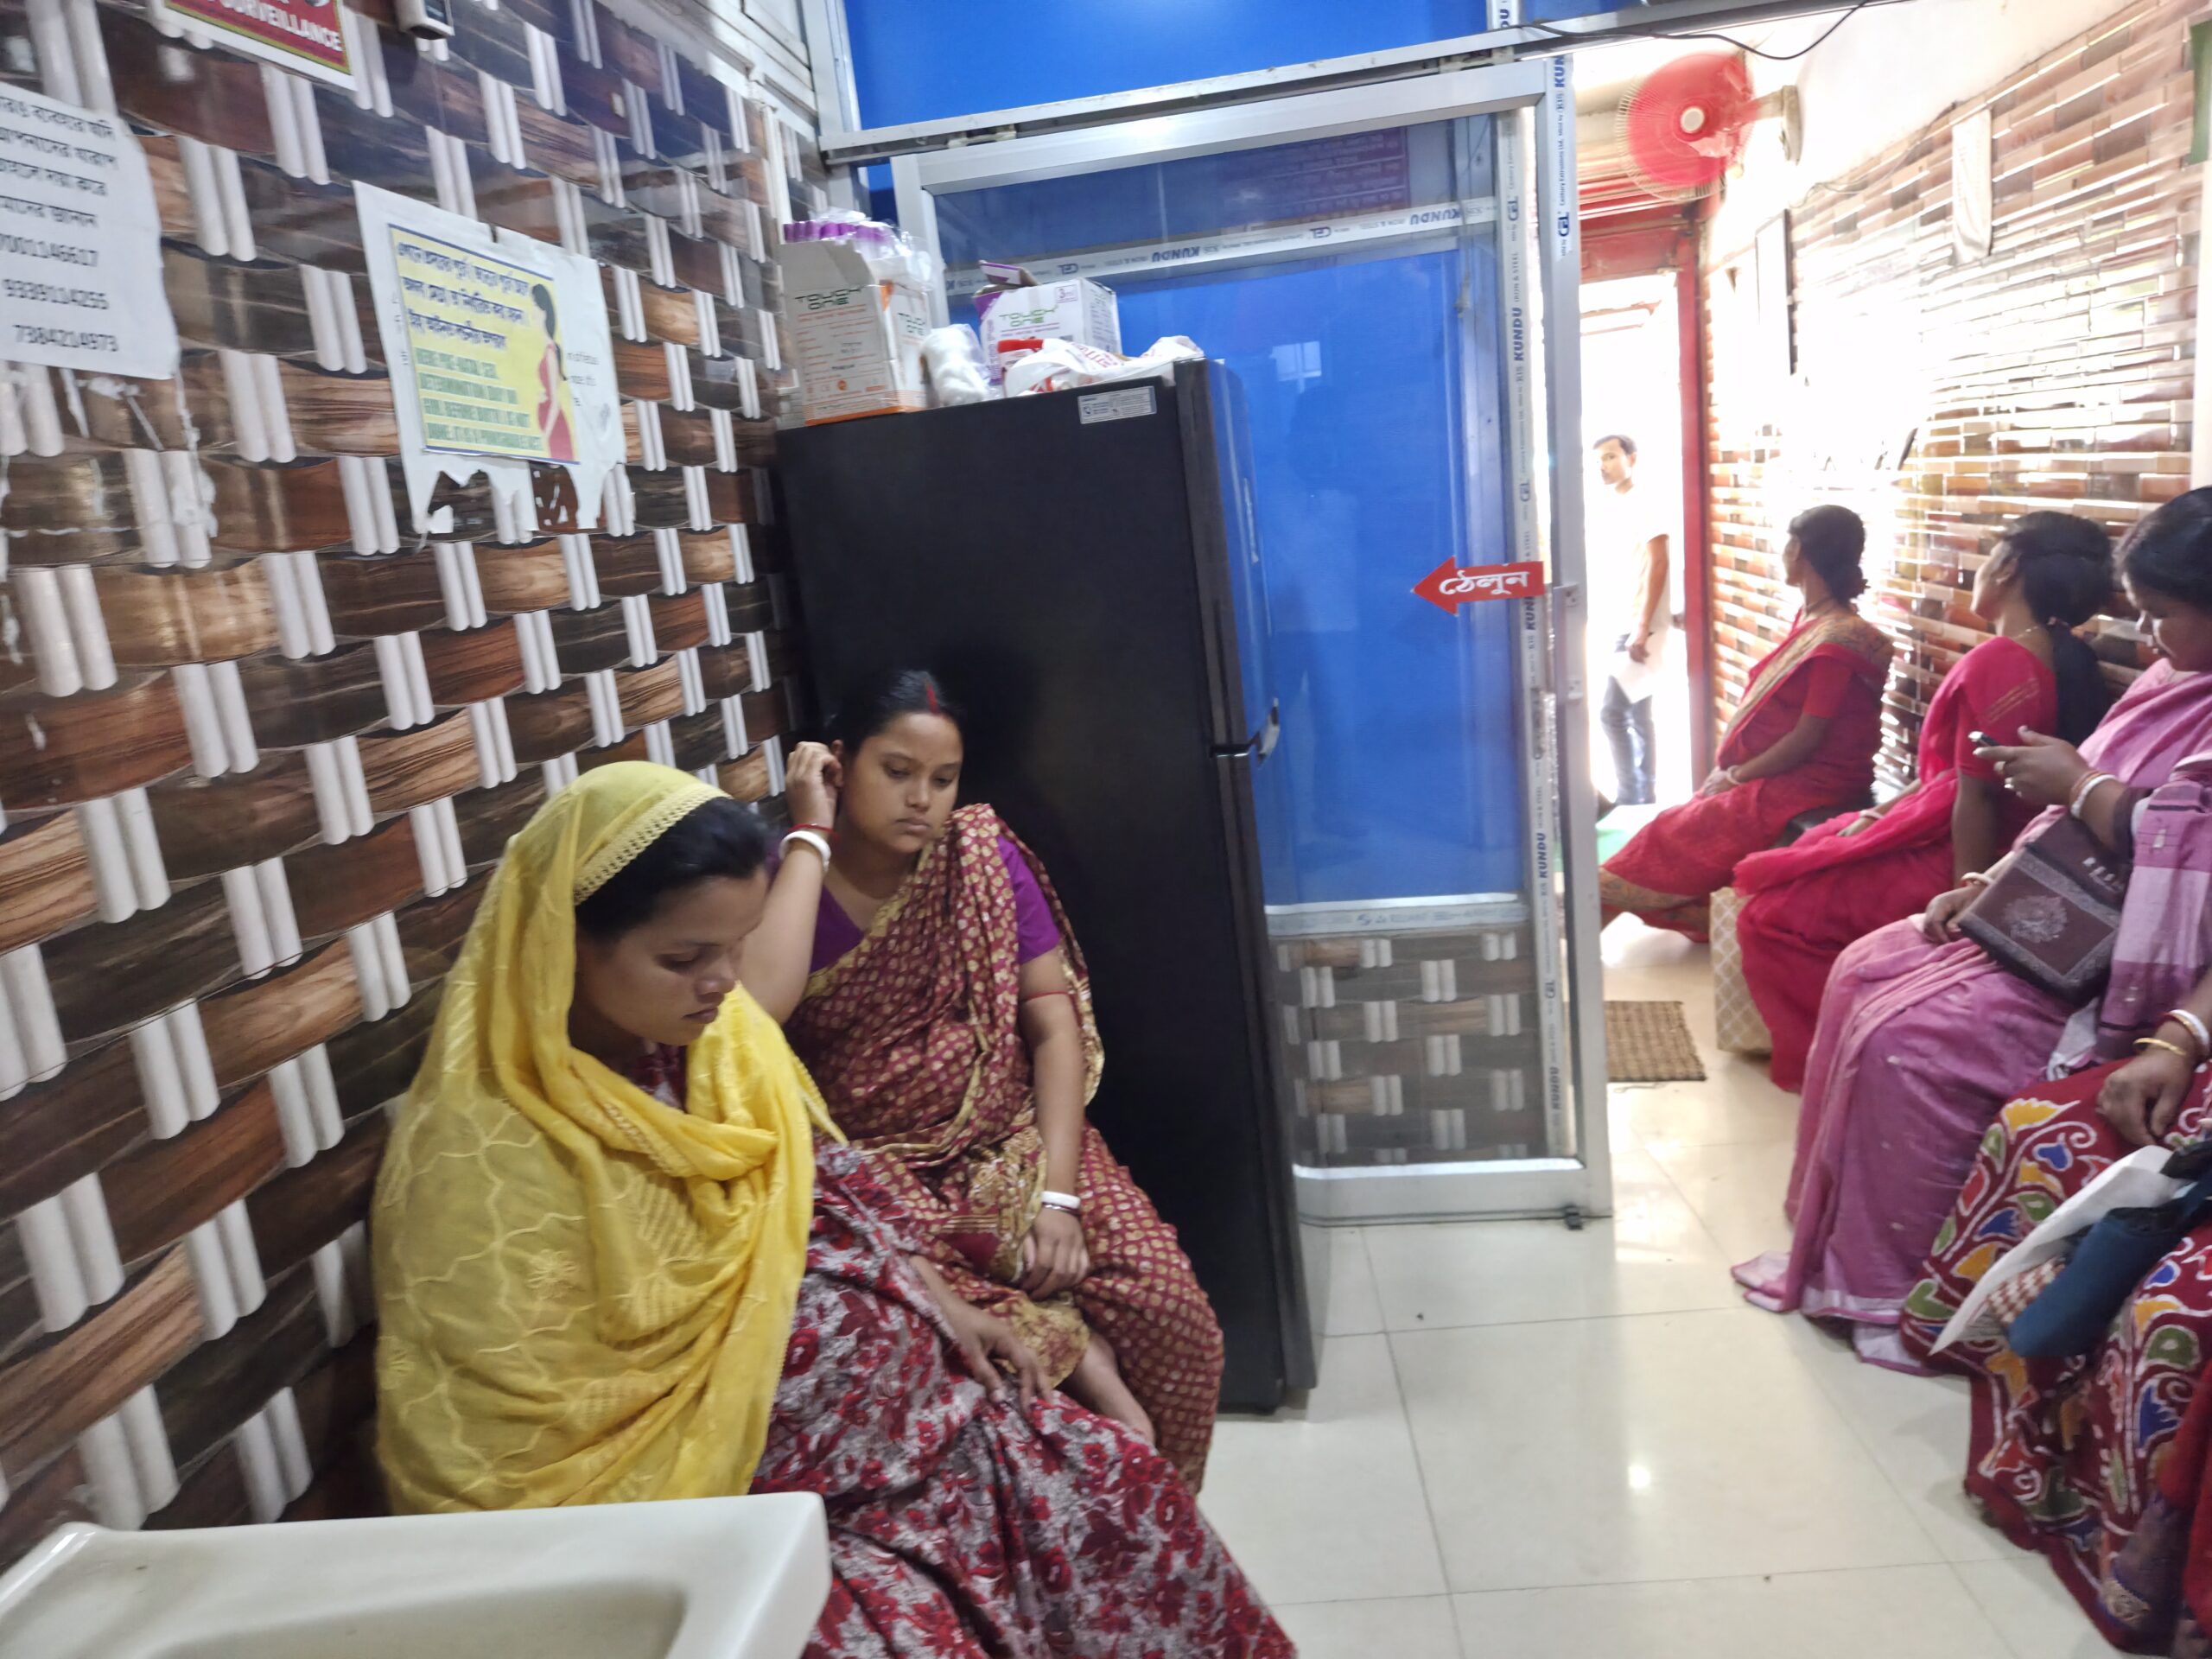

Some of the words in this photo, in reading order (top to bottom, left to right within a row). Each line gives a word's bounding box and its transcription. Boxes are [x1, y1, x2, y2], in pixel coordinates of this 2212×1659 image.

[1554, 55, 1565, 87] KUN
[1409, 207, 1462, 225] KUNDU
[1151, 245, 1201, 263] KUNDU
[794, 287, 864, 303] TOUCH
[808, 296, 850, 311] ONE
[999, 304, 1058, 320] TOUCH
[1512, 307, 1524, 361] KUNDU
[1439, 569, 1530, 595] ঠেলুন
[1525, 596, 1536, 631] KUN
[1537, 832, 1548, 879] KUNDU
